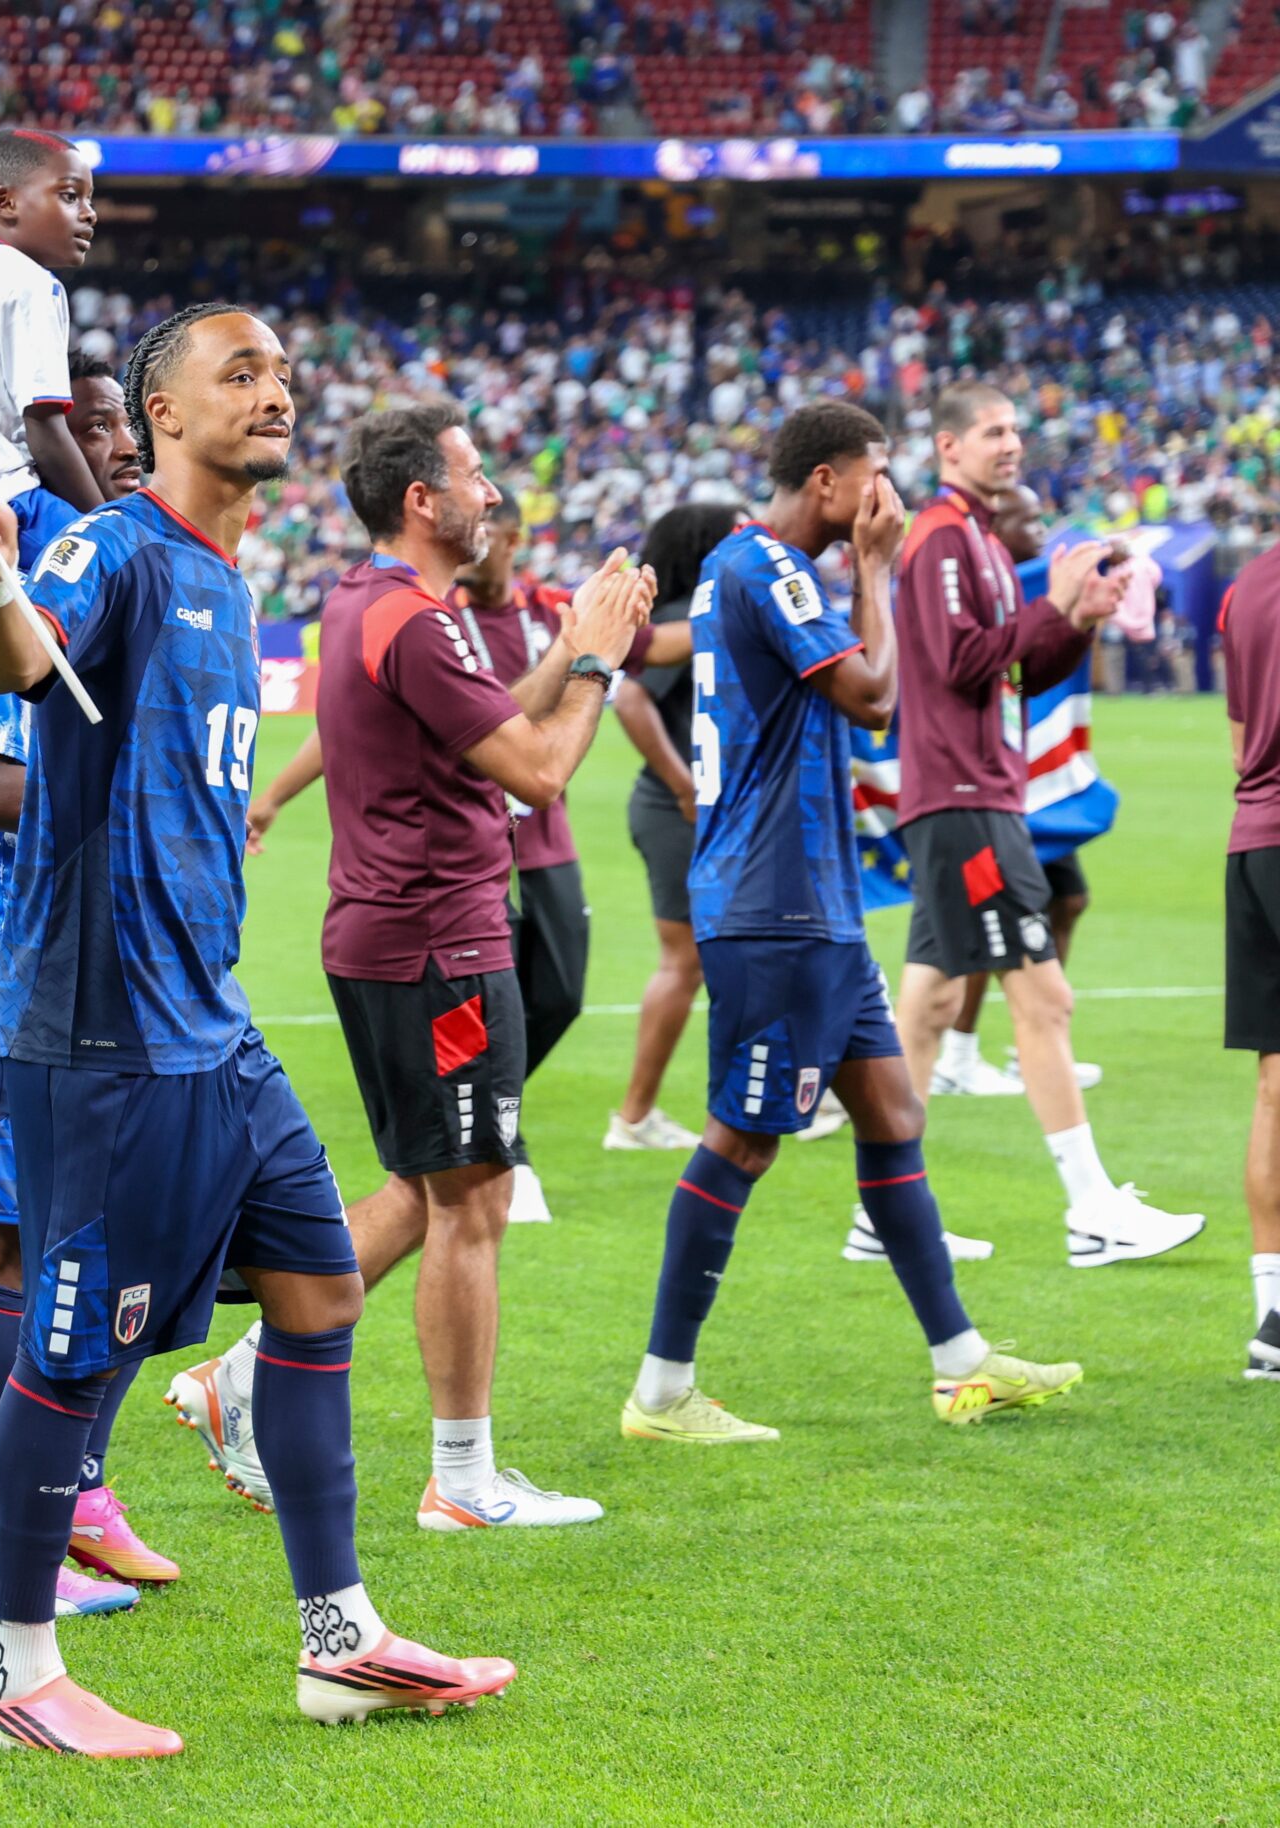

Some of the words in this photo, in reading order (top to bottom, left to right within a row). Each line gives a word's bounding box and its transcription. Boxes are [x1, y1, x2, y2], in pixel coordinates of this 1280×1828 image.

[176, 608, 213, 628] capelli
[206, 703, 258, 791] 19
[123, 1288, 148, 1302] FCF
